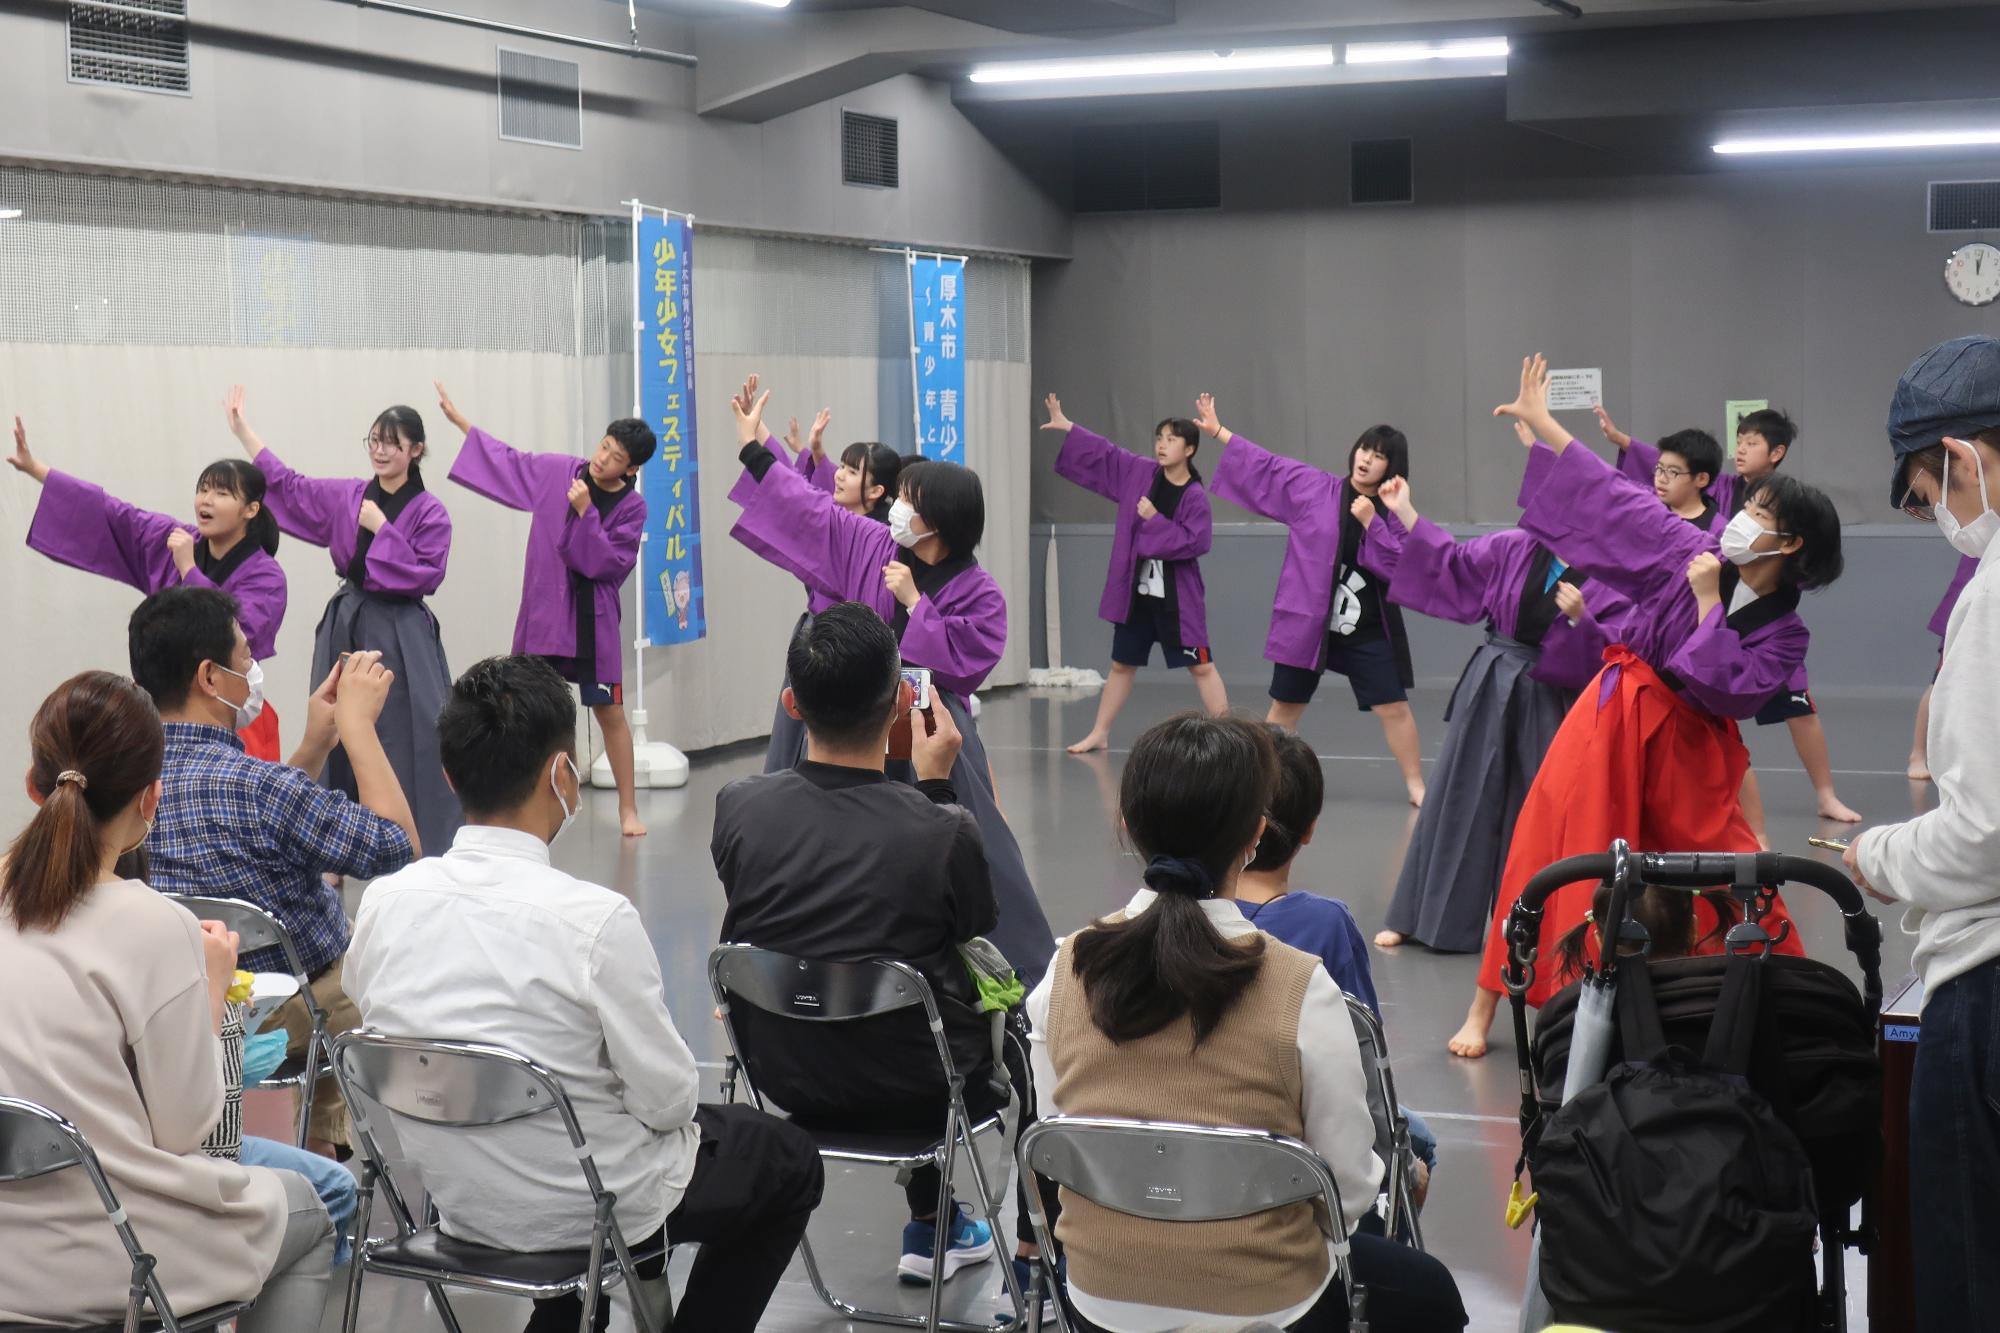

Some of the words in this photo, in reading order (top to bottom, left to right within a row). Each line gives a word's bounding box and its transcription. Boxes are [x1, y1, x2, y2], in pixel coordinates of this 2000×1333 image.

[940, 275, 957, 359] 厚木市
[653, 238, 686, 560] 少年少女フェスティバル
[940, 389, 957, 463] 青少
